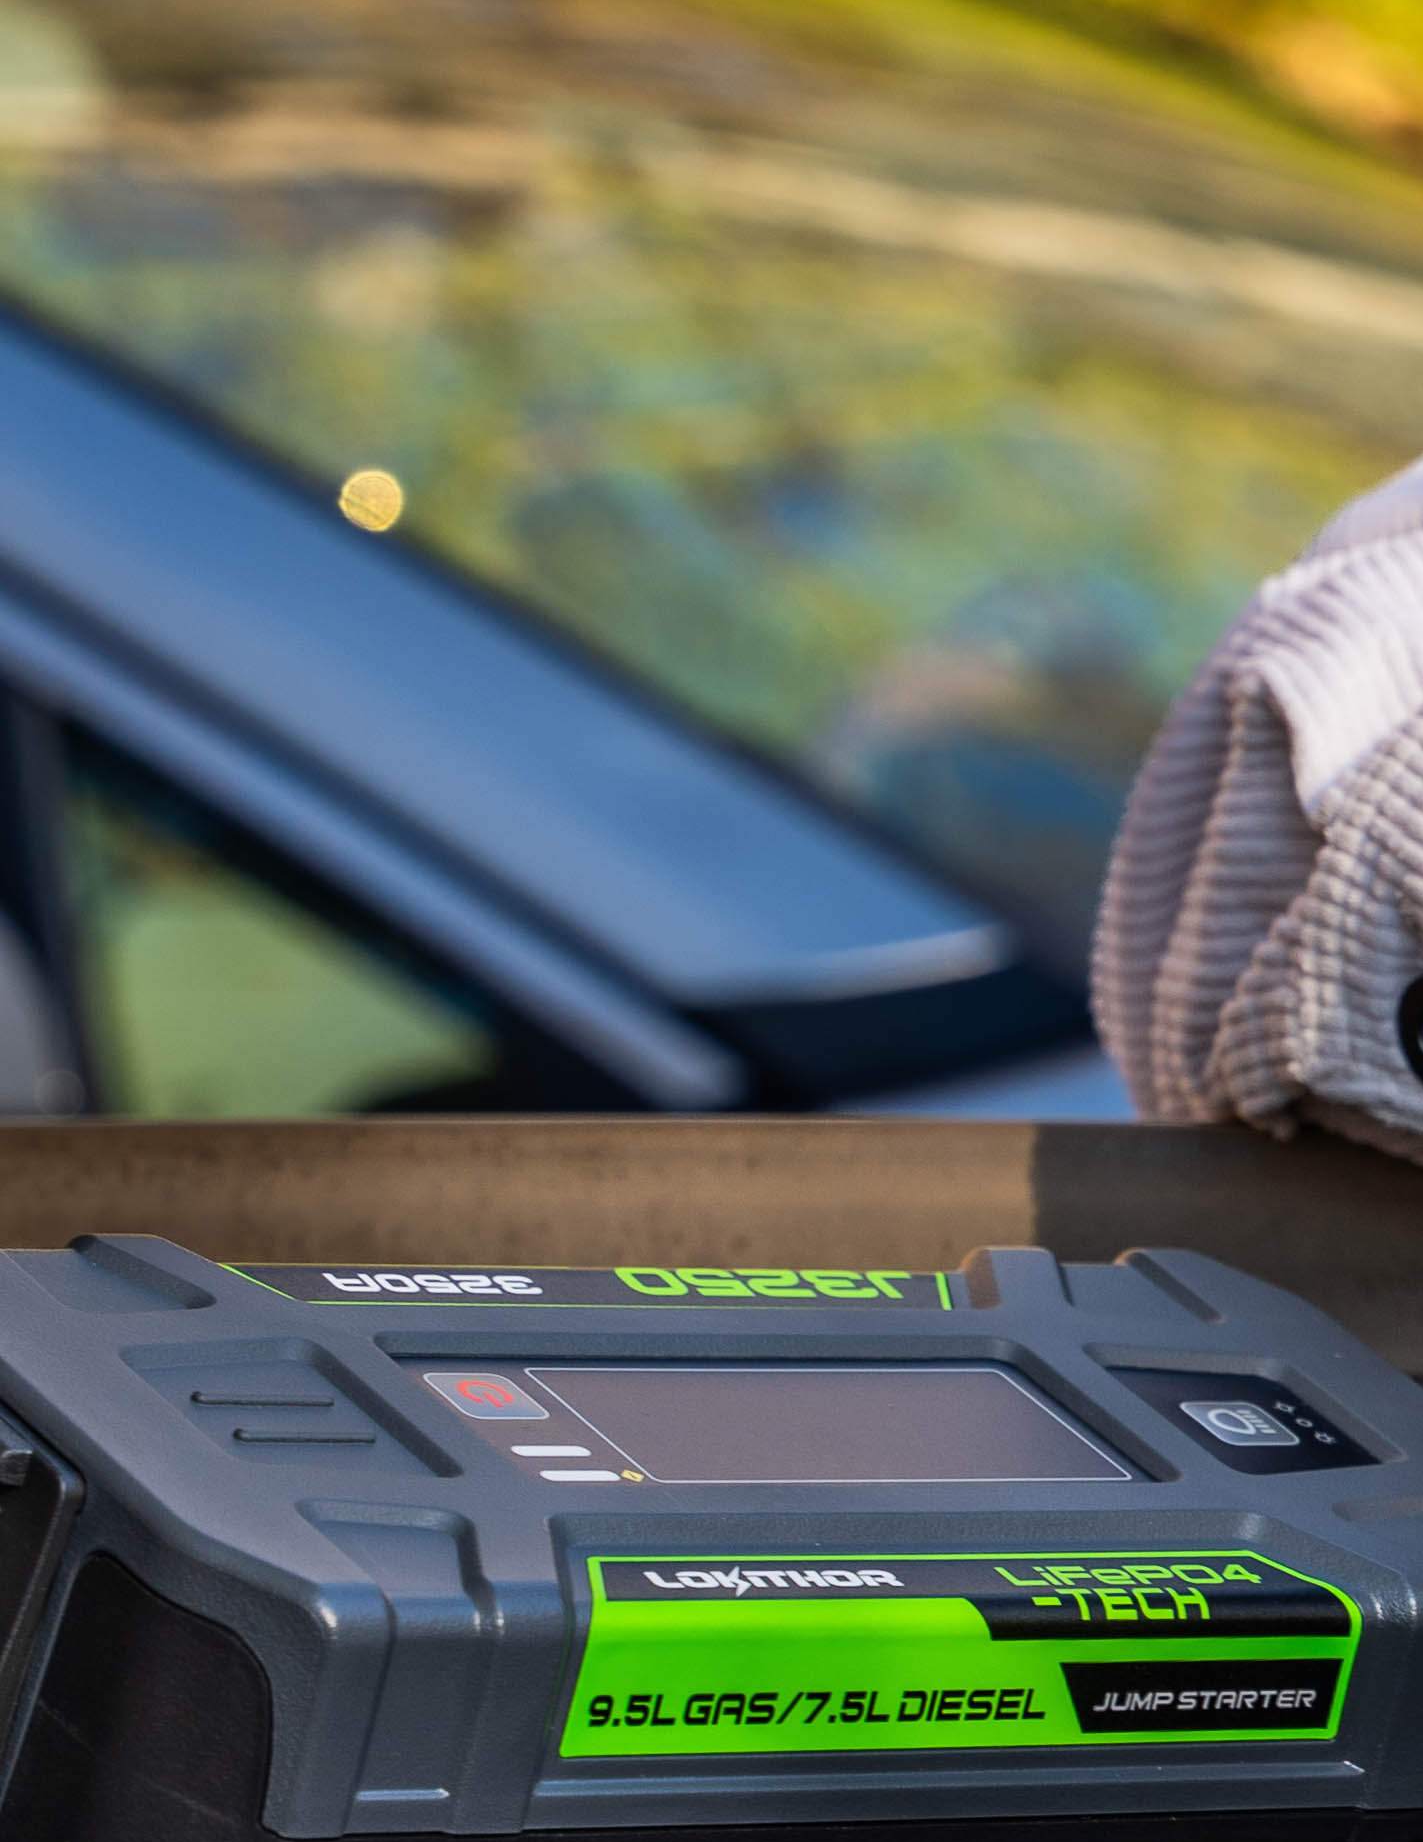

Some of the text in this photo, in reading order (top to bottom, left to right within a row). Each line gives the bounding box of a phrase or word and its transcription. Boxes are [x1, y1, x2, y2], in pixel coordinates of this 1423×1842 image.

[323, 1267, 912, 1299] J3250 3250A
[643, 1565, 906, 1597] LOKITHOR
[588, 1688, 1046, 1727] 9.5L GAS/7.5L DIESEL
[1092, 1689, 1318, 1713] JUMP STARTER
